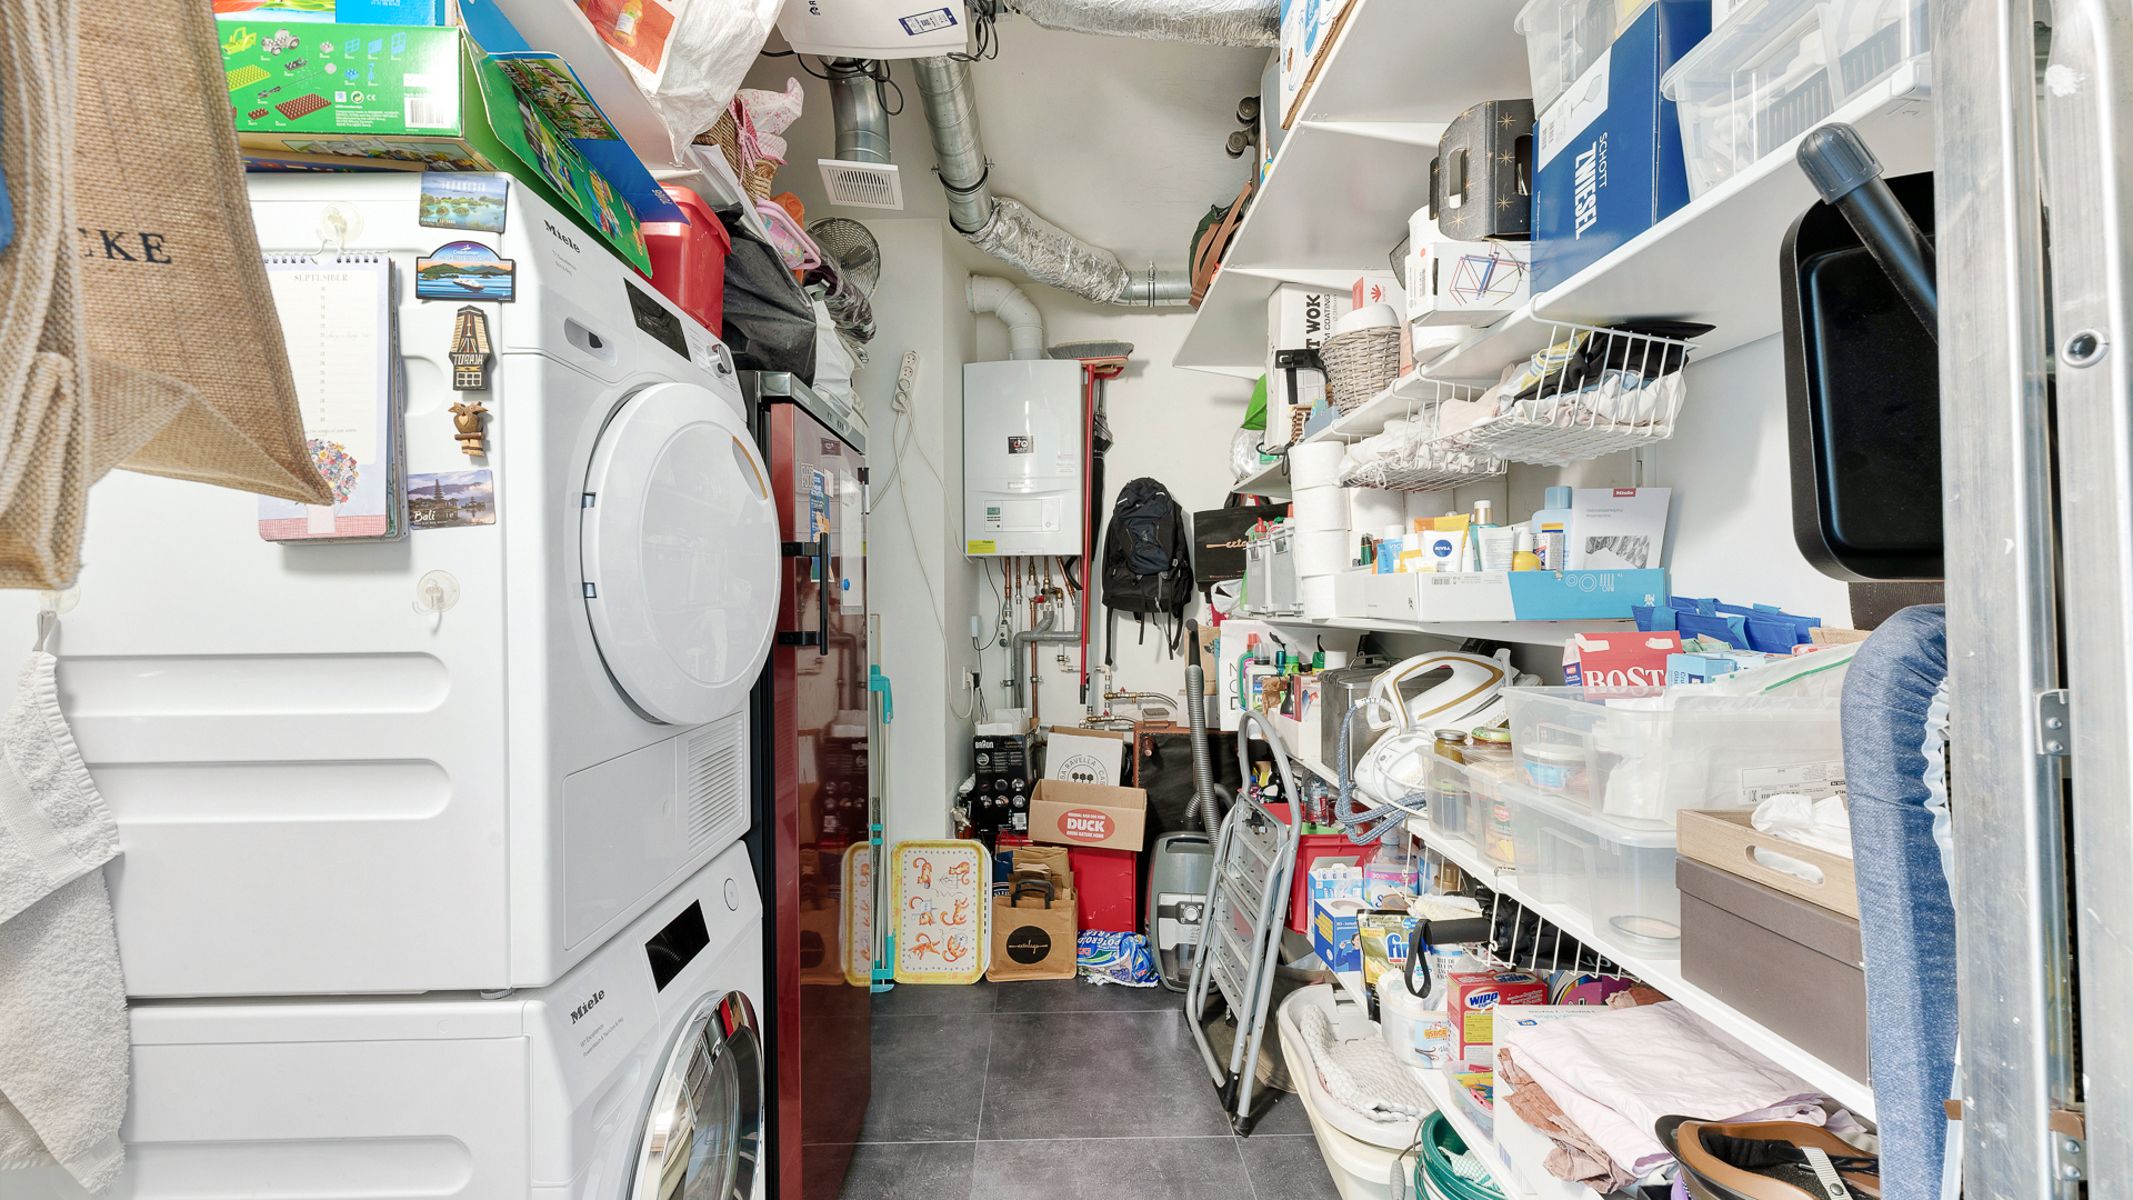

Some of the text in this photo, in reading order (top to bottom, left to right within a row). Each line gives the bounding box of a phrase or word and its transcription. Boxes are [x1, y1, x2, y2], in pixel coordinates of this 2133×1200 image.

[1598, 131, 1608, 189] SCHOTT
[1574, 140, 1598, 241] ZWIESEL
[543, 219, 581, 254] Miele
[293, 273, 349, 282] SEPTEMBER
[1306, 294, 1320, 334] WOK
[413, 509, 436, 522] Bali
[1584, 666, 1665, 697] BOST
[1065, 757, 1096, 770] RAVELLA
[1067, 818, 1105, 832] DUCK
[570, 989, 605, 1025] Miele
